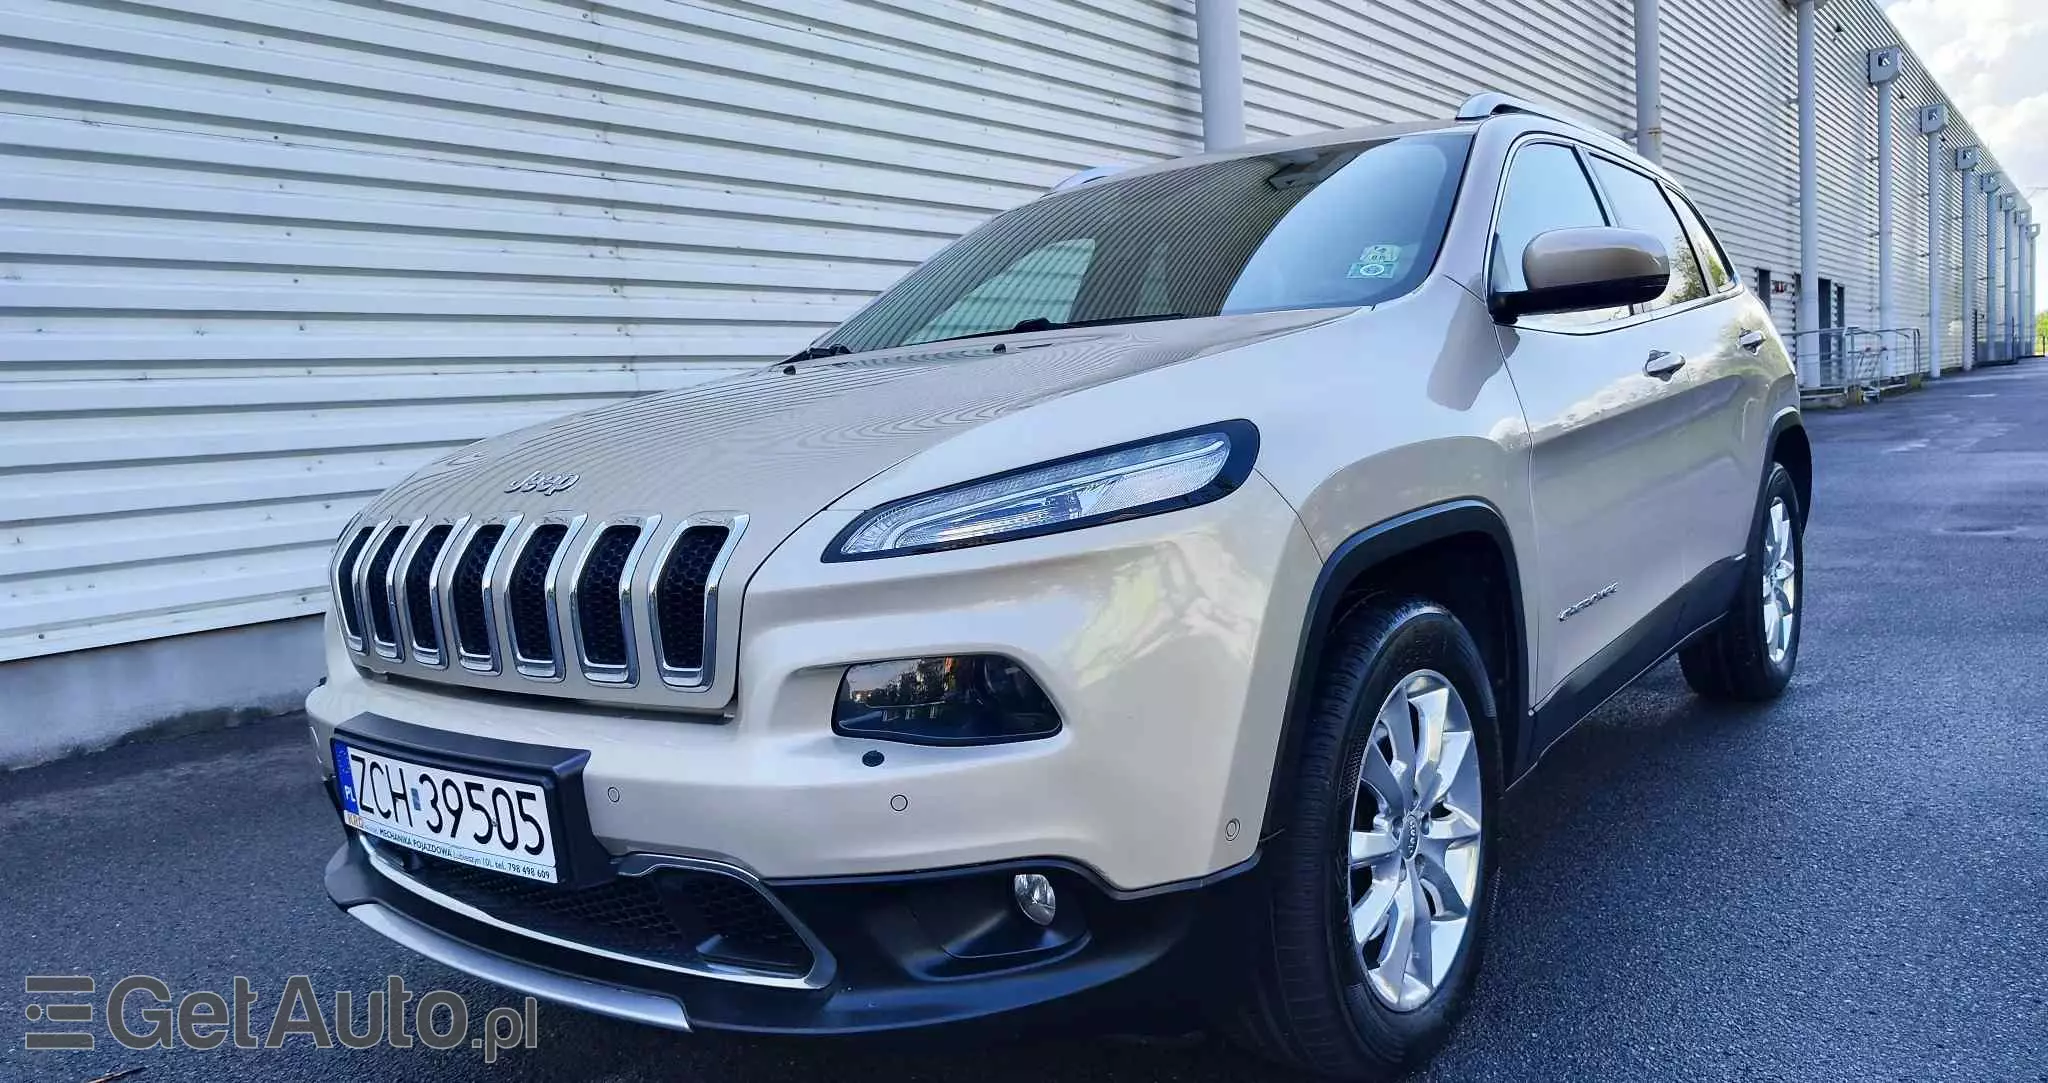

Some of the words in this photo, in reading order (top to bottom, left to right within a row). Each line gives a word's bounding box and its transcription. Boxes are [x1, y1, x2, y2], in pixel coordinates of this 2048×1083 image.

[504, 470, 581, 497] Jeep
[344, 784, 357, 802] PL
[351, 753, 414, 828] ZCH
[418, 773, 545, 856] 39505
[507, 862, 521, 874] 798
[522, 865, 535, 877] 498
[537, 869, 551, 880] 609
